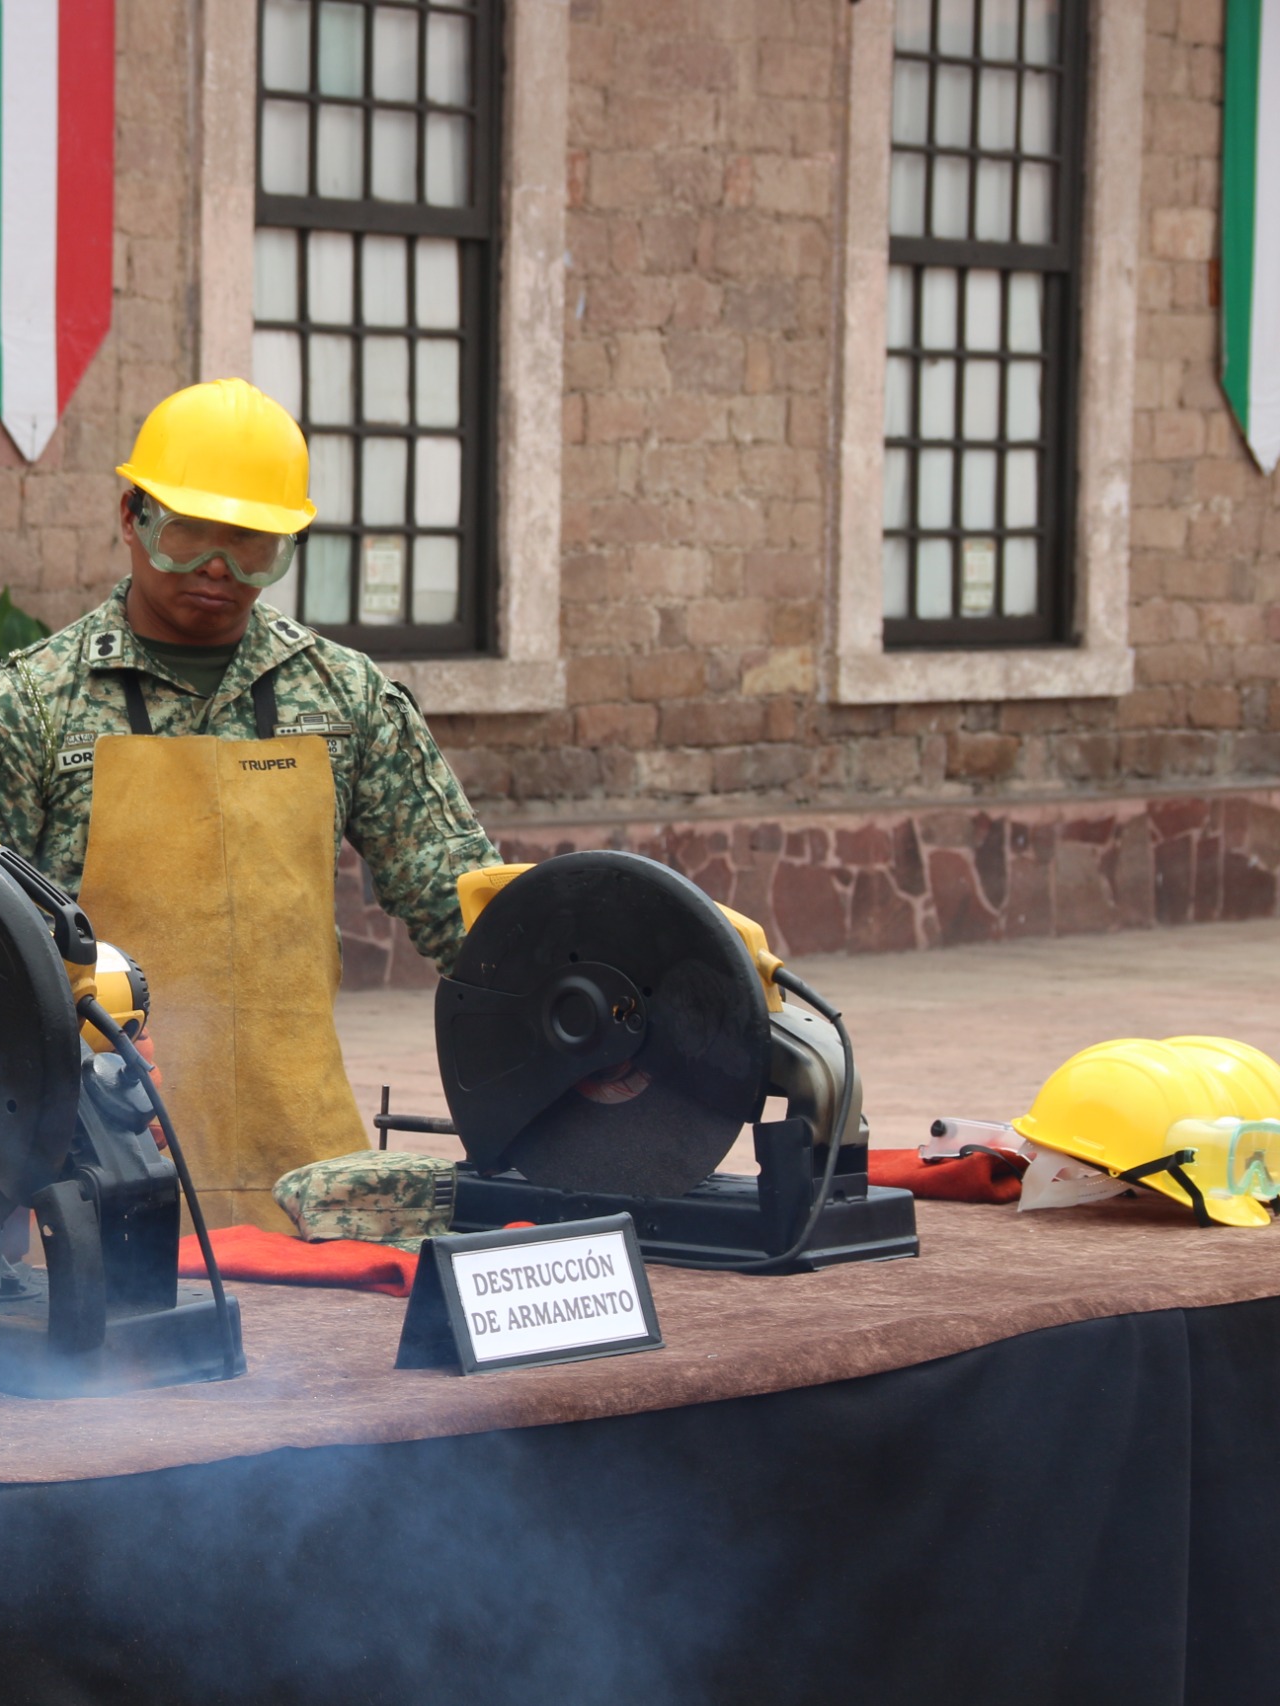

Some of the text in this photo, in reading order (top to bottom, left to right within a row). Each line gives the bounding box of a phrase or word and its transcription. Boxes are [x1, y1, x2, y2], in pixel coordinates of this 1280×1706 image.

[62, 751, 94, 766] LOR
[238, 757, 297, 771] TRUPER
[472, 1249, 615, 1296] DESTRUCCIÓN
[471, 1290, 634, 1335] DE ARMAMENTO
